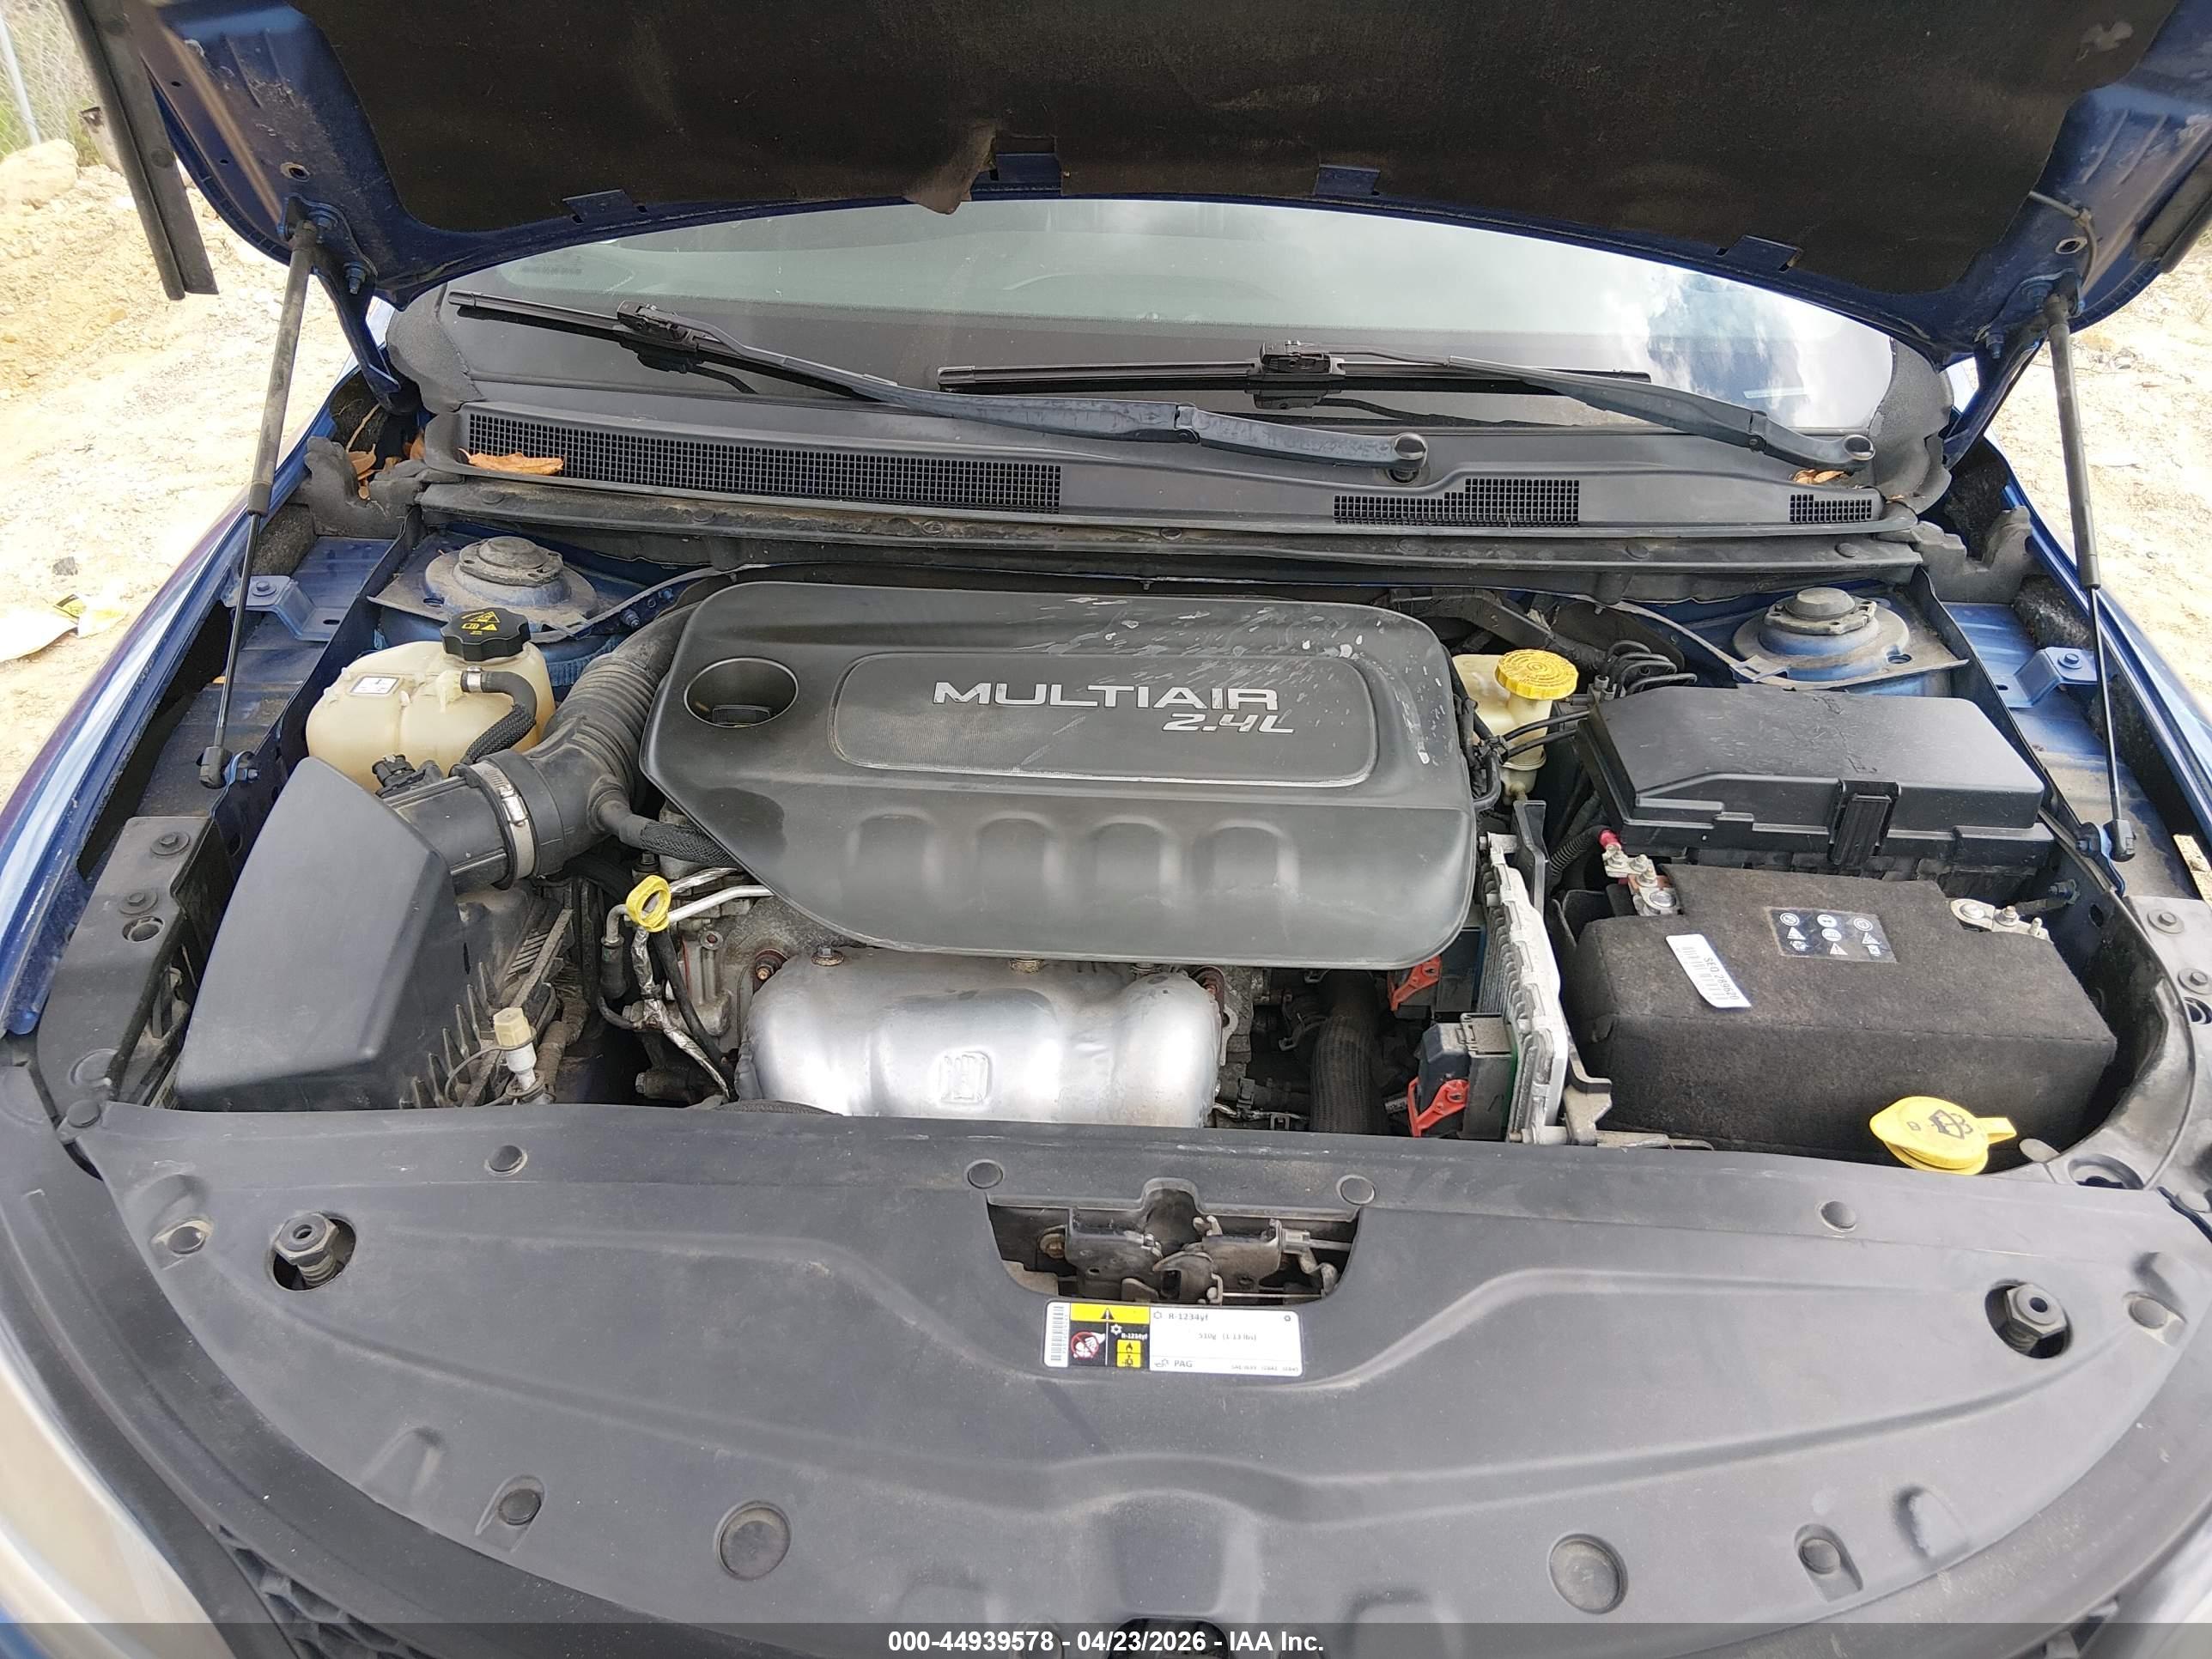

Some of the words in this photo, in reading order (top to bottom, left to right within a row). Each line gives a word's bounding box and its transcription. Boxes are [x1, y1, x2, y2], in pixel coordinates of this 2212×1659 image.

[933, 681, 1279, 711] MULTIAIR
[1162, 712, 1295, 734] 2.4L
[1168, 1313, 1209, 1322] R-1234yf
[1174, 1359, 1194, 1368] PAG
